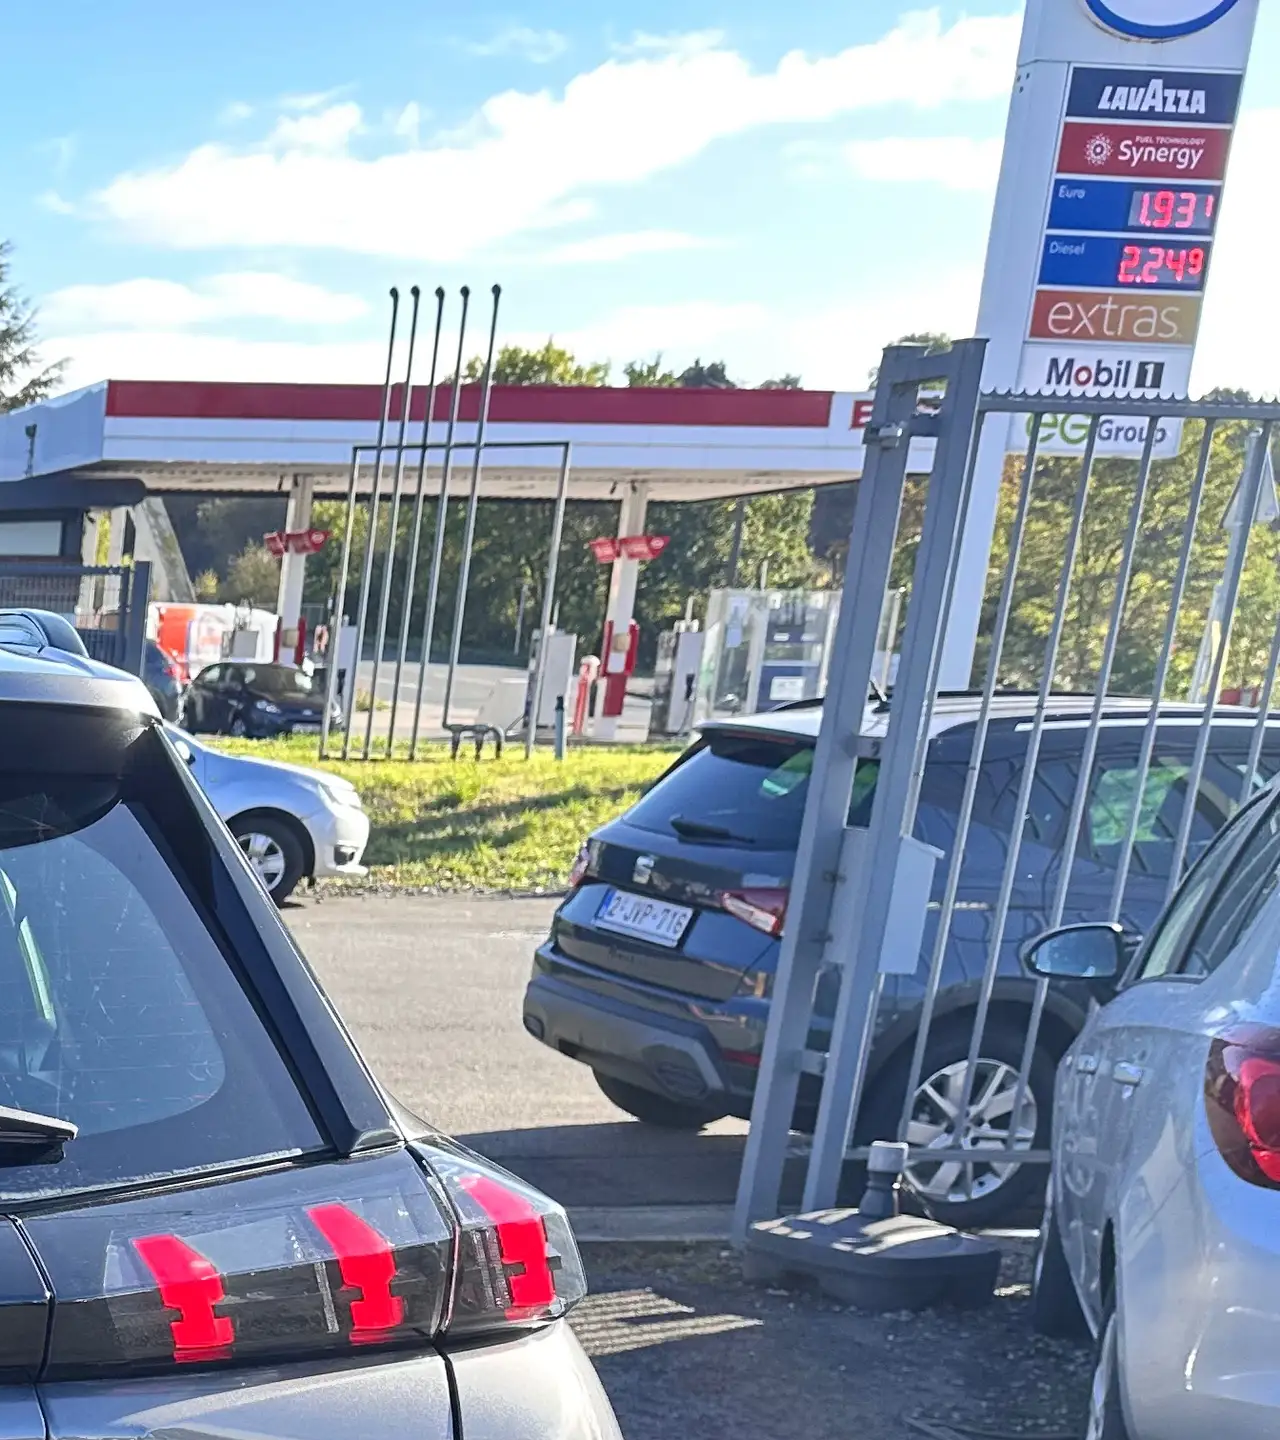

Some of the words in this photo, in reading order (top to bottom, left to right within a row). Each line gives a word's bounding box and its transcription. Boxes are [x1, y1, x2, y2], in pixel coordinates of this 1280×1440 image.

[1118, 139, 1204, 170] Synergy
[1058, 185, 1086, 199] Euro
[1049, 241, 1086, 255] Diesel
[1118, 245, 1204, 283] 2.249
[1047, 296, 1182, 338] extras
[1045, 357, 1132, 389] Mobil
